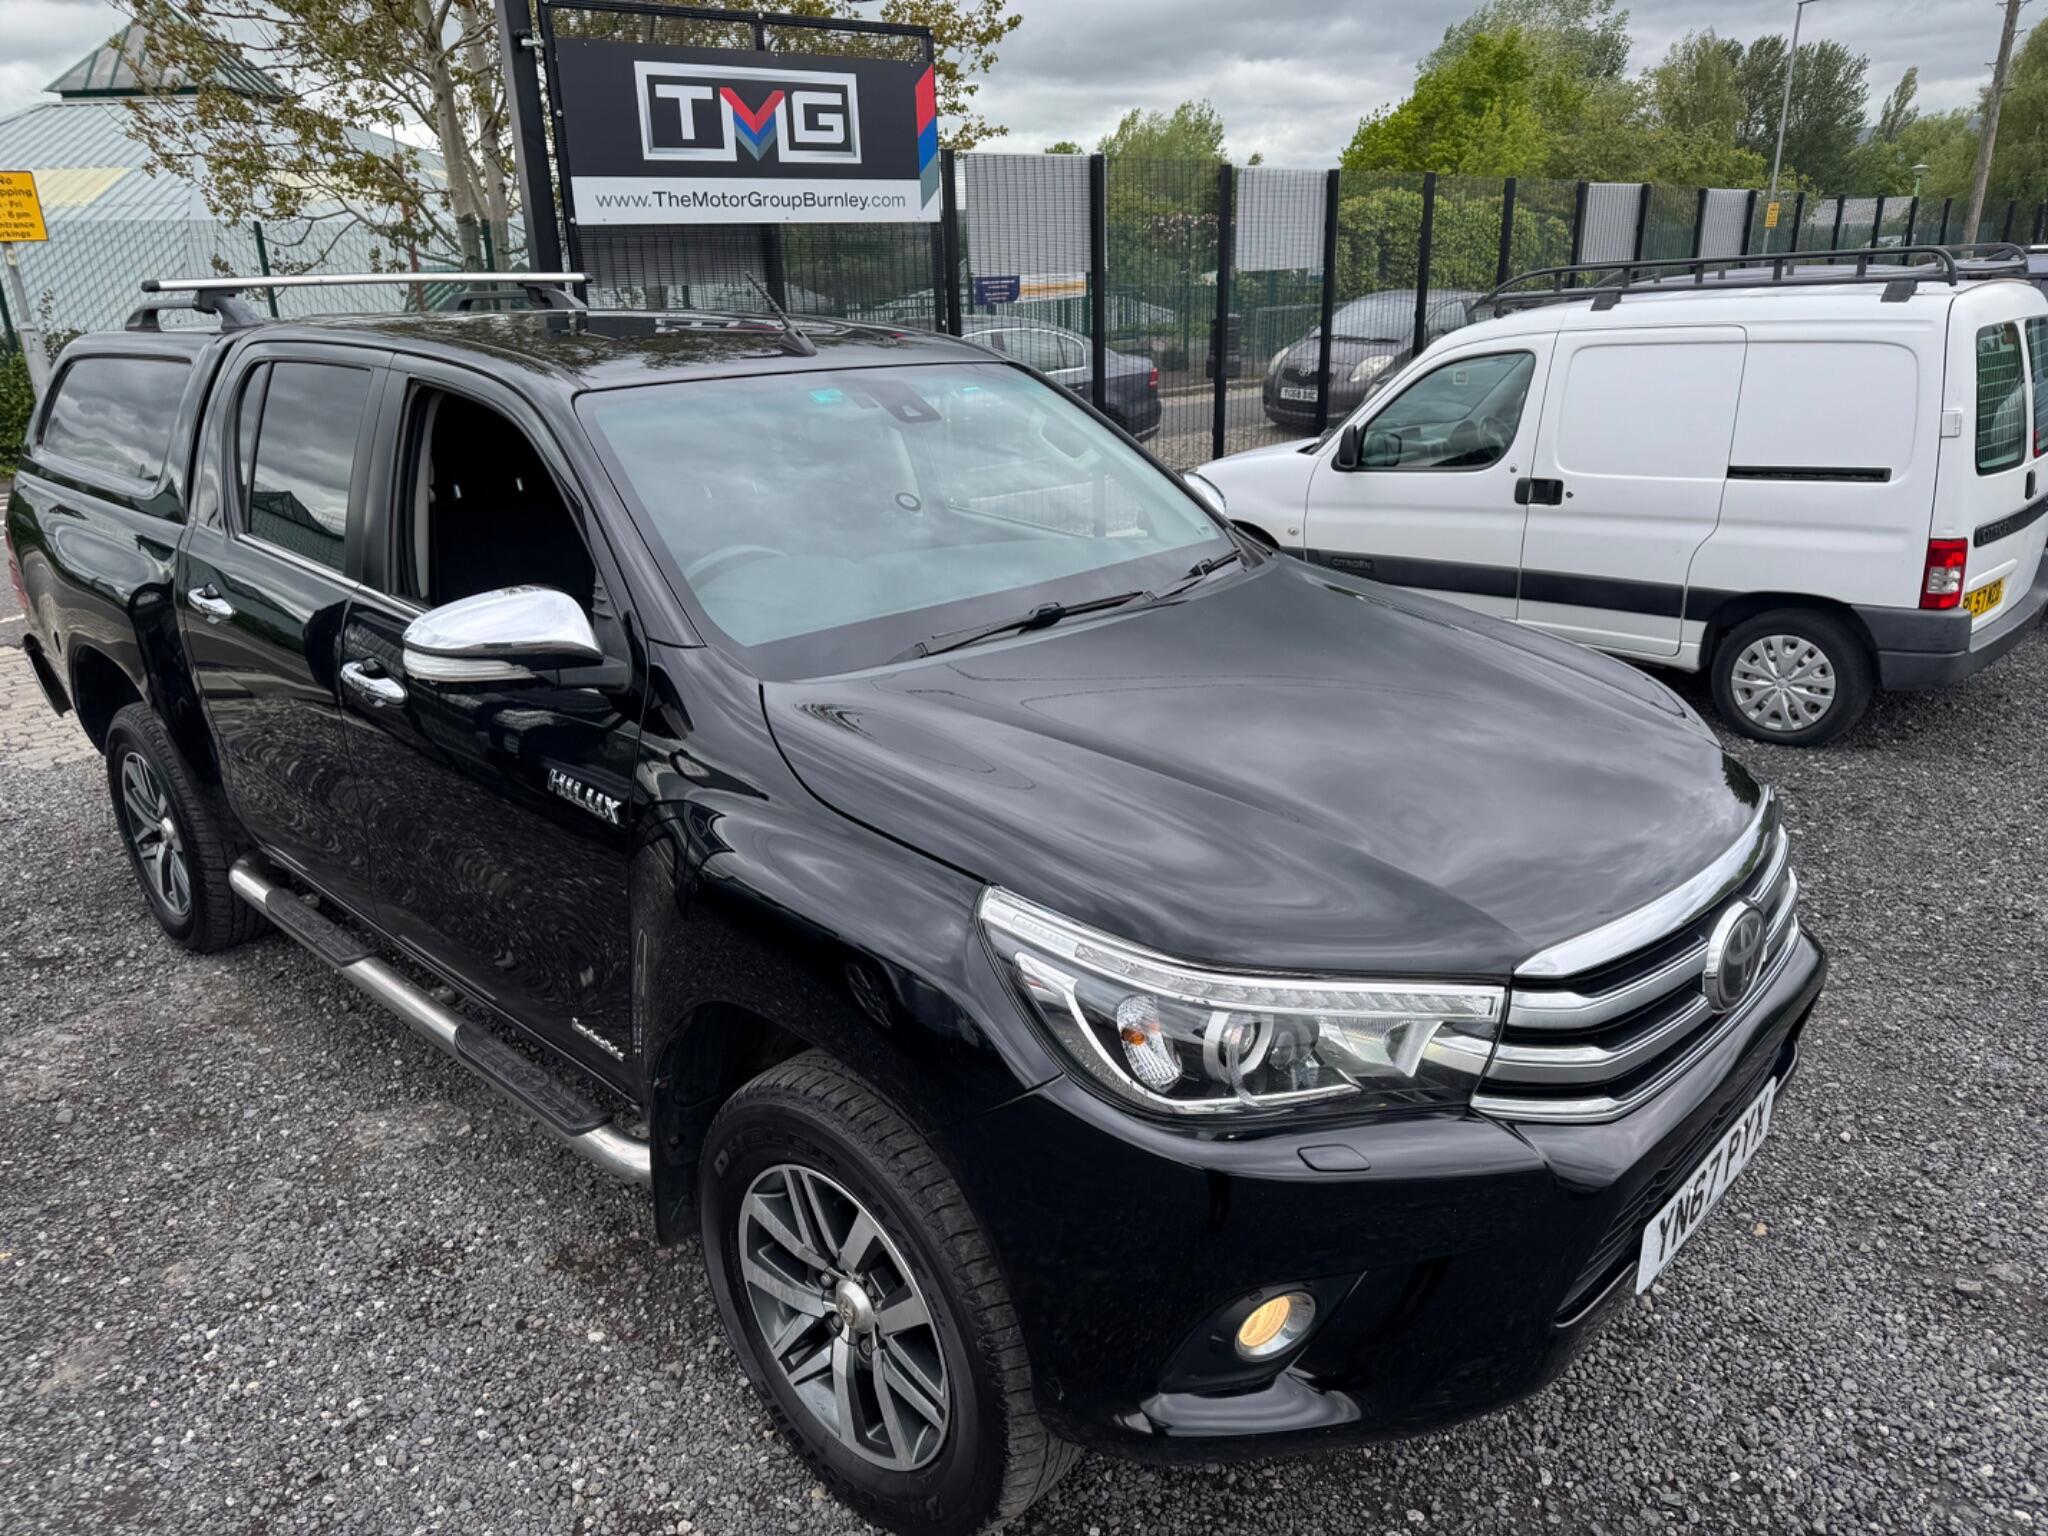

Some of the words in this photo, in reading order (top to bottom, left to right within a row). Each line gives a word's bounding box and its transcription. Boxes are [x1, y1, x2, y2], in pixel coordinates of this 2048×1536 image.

[655, 84, 846, 161] TMG
[595, 191, 906, 211] www.TheMotorGroupBurnley.com
[547, 768, 622, 825] HILUX
[1659, 1148, 1723, 1262] YN67
[1724, 1091, 1769, 1183] PYX
